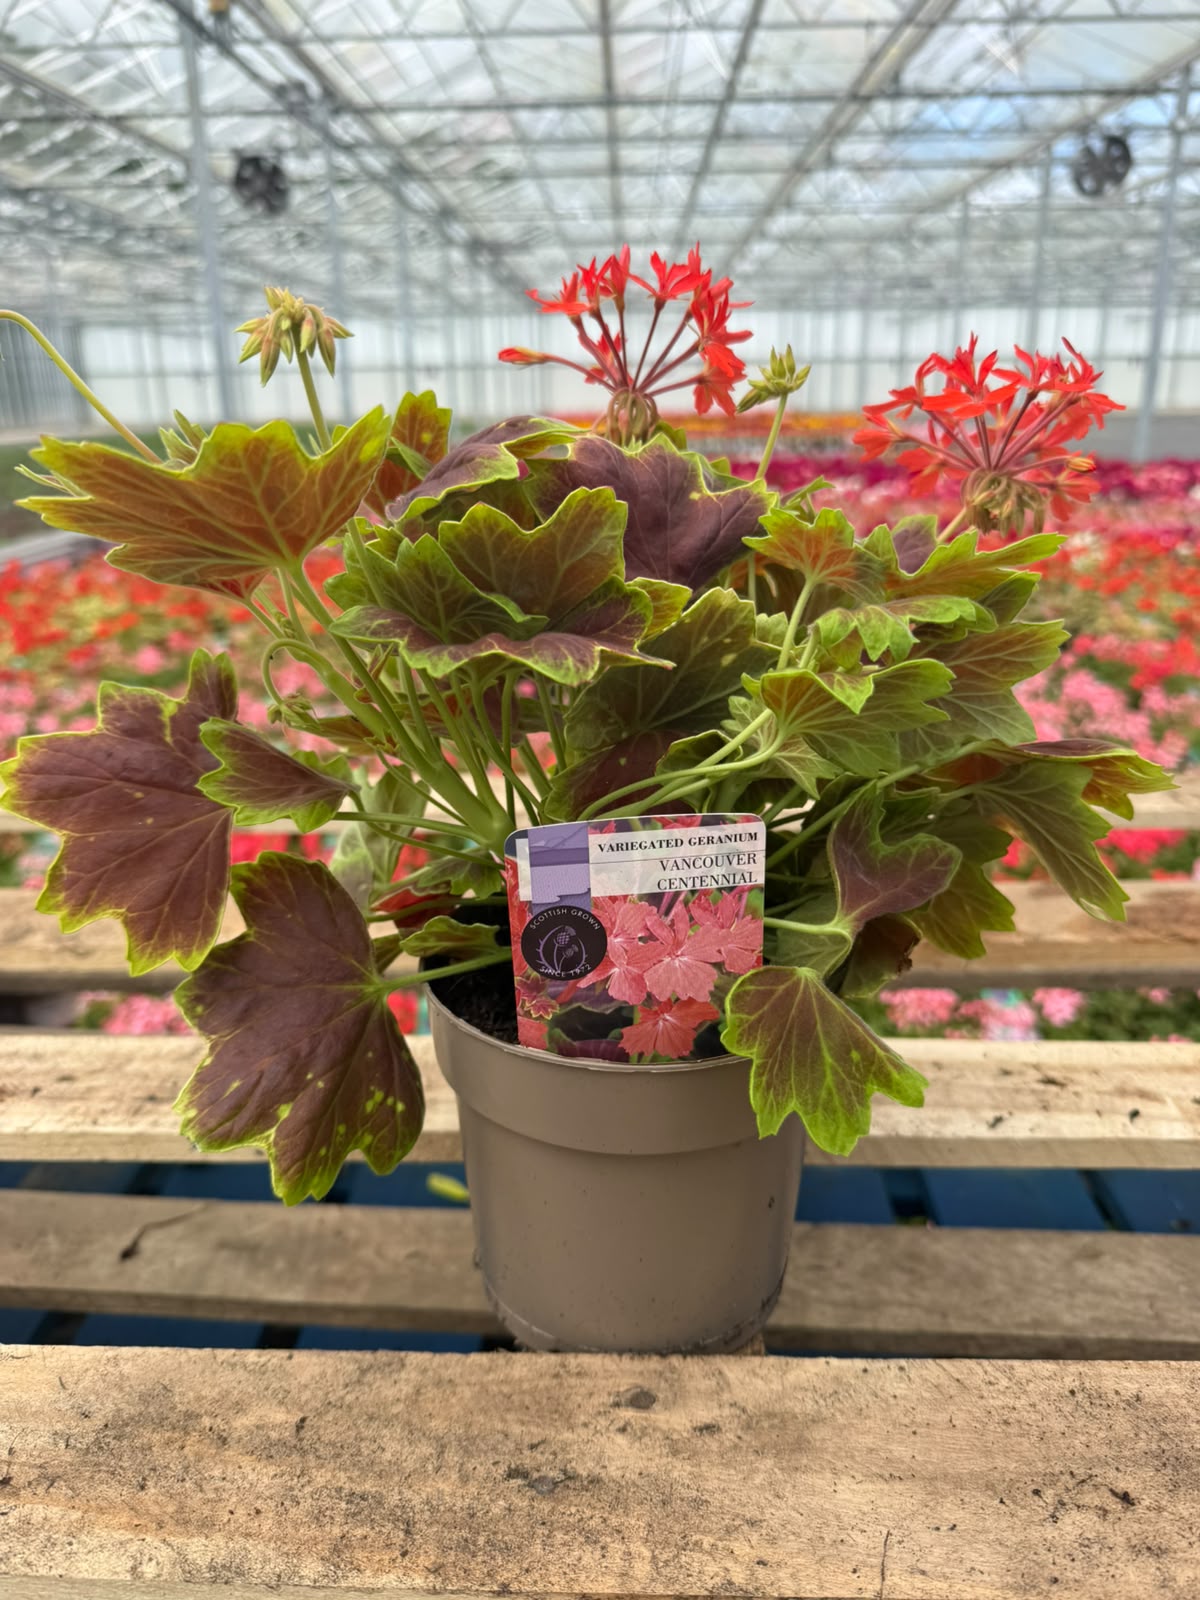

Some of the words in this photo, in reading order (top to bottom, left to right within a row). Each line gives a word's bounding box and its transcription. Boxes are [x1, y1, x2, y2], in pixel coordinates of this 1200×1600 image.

[598, 838, 684, 852] VARIEGATED
[688, 832, 758, 846] GERANIUM
[660, 852, 757, 871] VANCOUVER
[657, 871, 758, 891] CENTENNIAL
[529, 908, 567, 929] SCOTTISH
[571, 909, 601, 930] GROWN
[539, 965, 566, 977] SINCE
[570, 964, 592, 977] 1972
